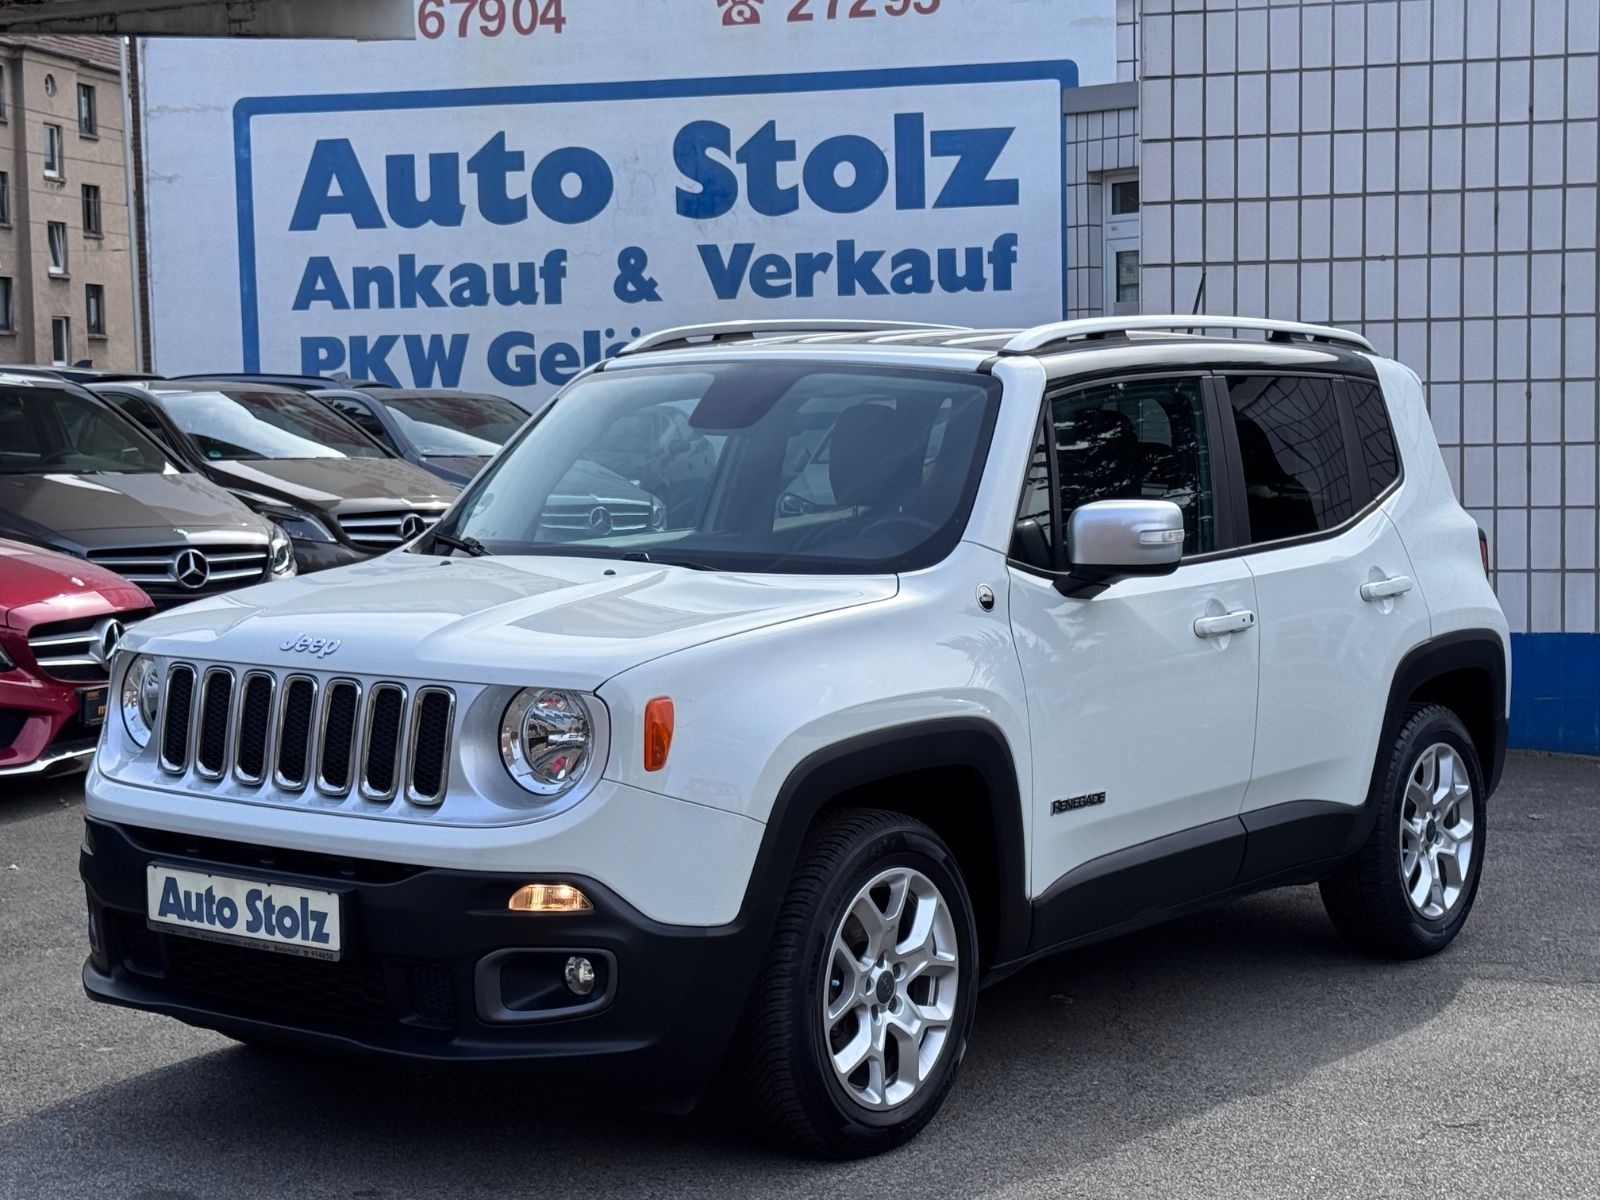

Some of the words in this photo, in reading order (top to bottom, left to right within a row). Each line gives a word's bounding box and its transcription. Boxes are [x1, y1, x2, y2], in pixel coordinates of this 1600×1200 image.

[418, 0, 566, 39] 67904
[289, 131, 614, 231] Auto
[673, 112, 1019, 219] Stolz
[292, 249, 567, 310] Ankauf
[614, 246, 661, 303] &
[697, 233, 1018, 300] Verkauf
[301, 334, 468, 388] PKW
[279, 632, 341, 659] Jeep
[158, 876, 239, 929] Auto
[245, 888, 331, 944] Stolz
